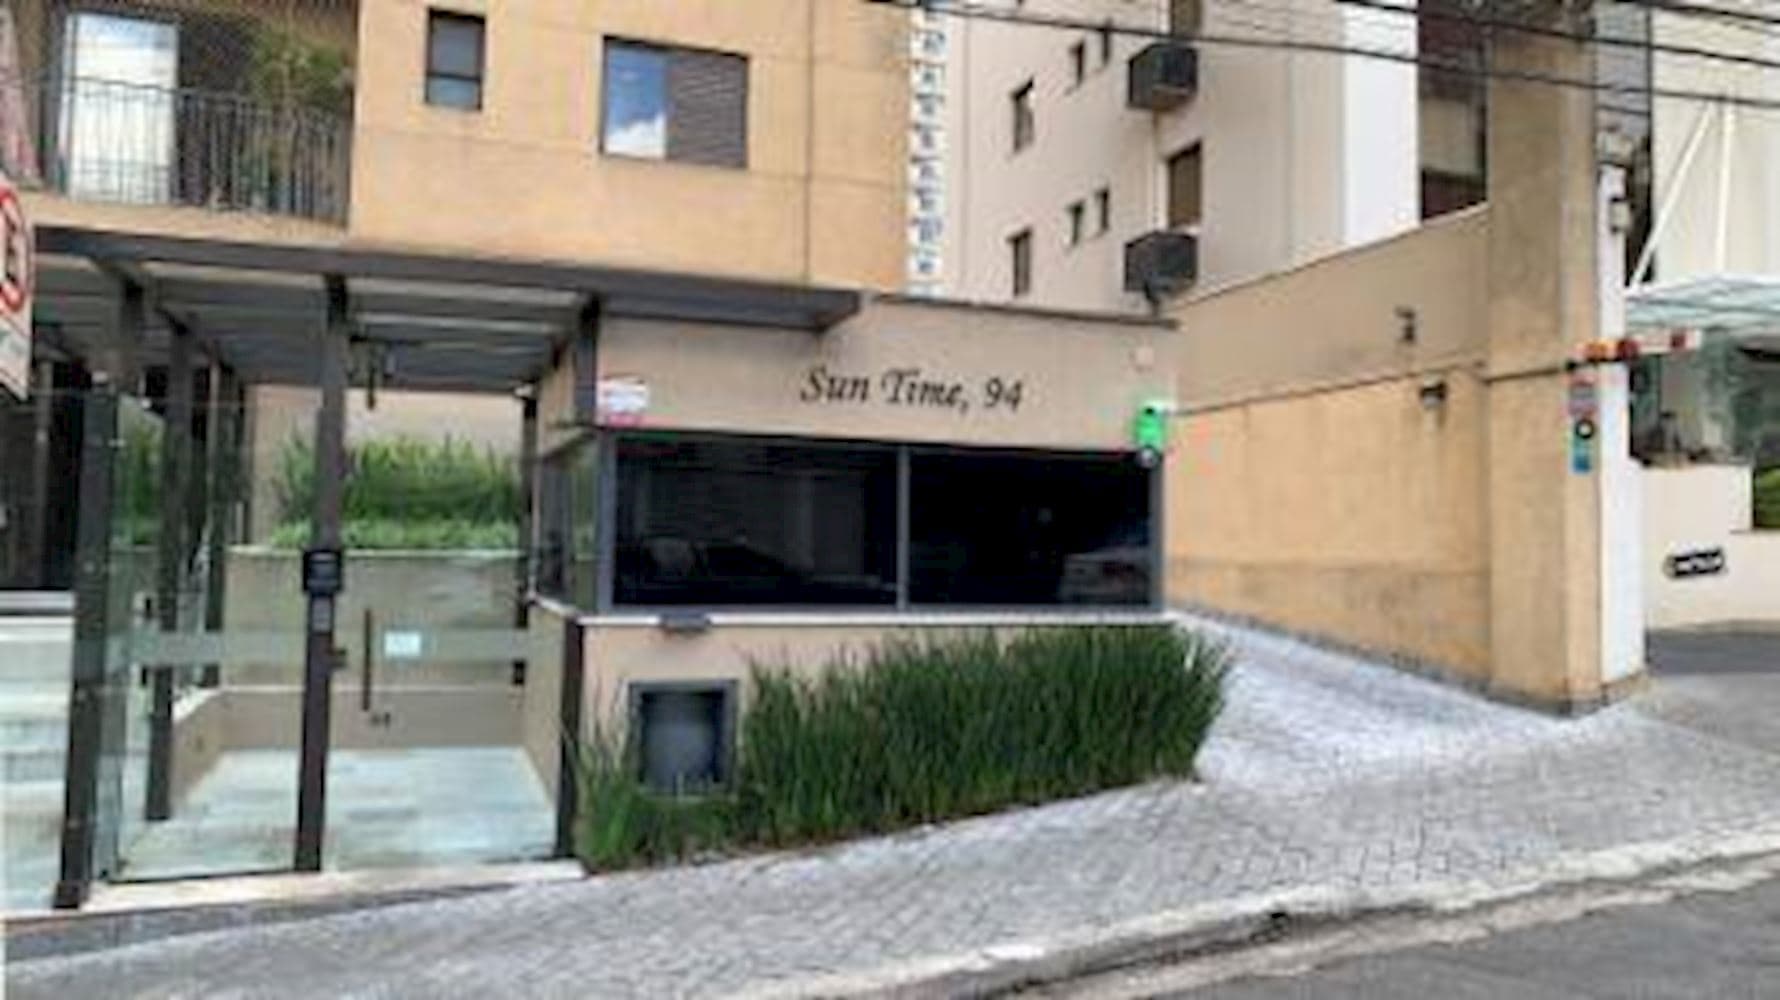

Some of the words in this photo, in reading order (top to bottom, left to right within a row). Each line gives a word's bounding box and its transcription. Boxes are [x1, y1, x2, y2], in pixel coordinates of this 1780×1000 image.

[800, 364, 870, 403] Sun
[880, 367, 969, 414] Time,
[984, 375, 1023, 412] 94
